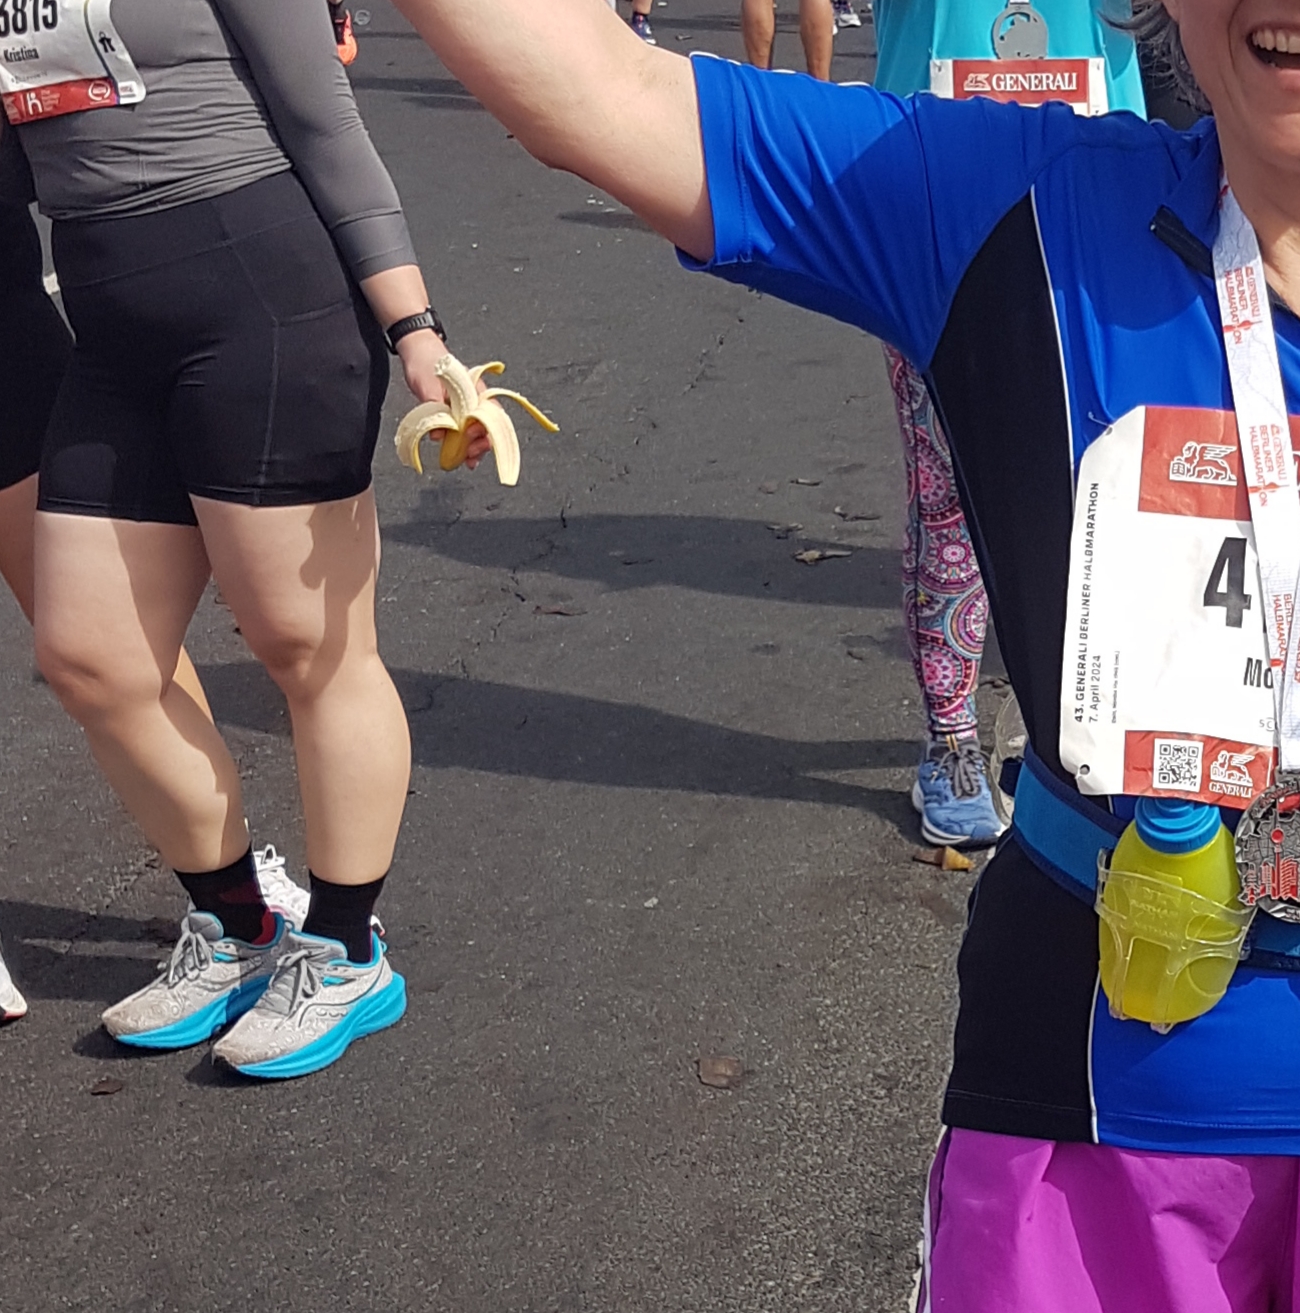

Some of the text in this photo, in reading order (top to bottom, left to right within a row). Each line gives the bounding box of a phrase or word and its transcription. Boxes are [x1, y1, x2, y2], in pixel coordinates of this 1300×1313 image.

[3, 46, 40, 64] Kristina
[991, 72, 1078, 92] GENERALI
[1259, 424, 1274, 473] BERLINER
[1074, 482, 1099, 723] 43. GENERALI BERLINER HALBMARATHON
[1088, 654, 1102, 723] 7. April 2024
[1208, 781, 1253, 799] GENERALI
